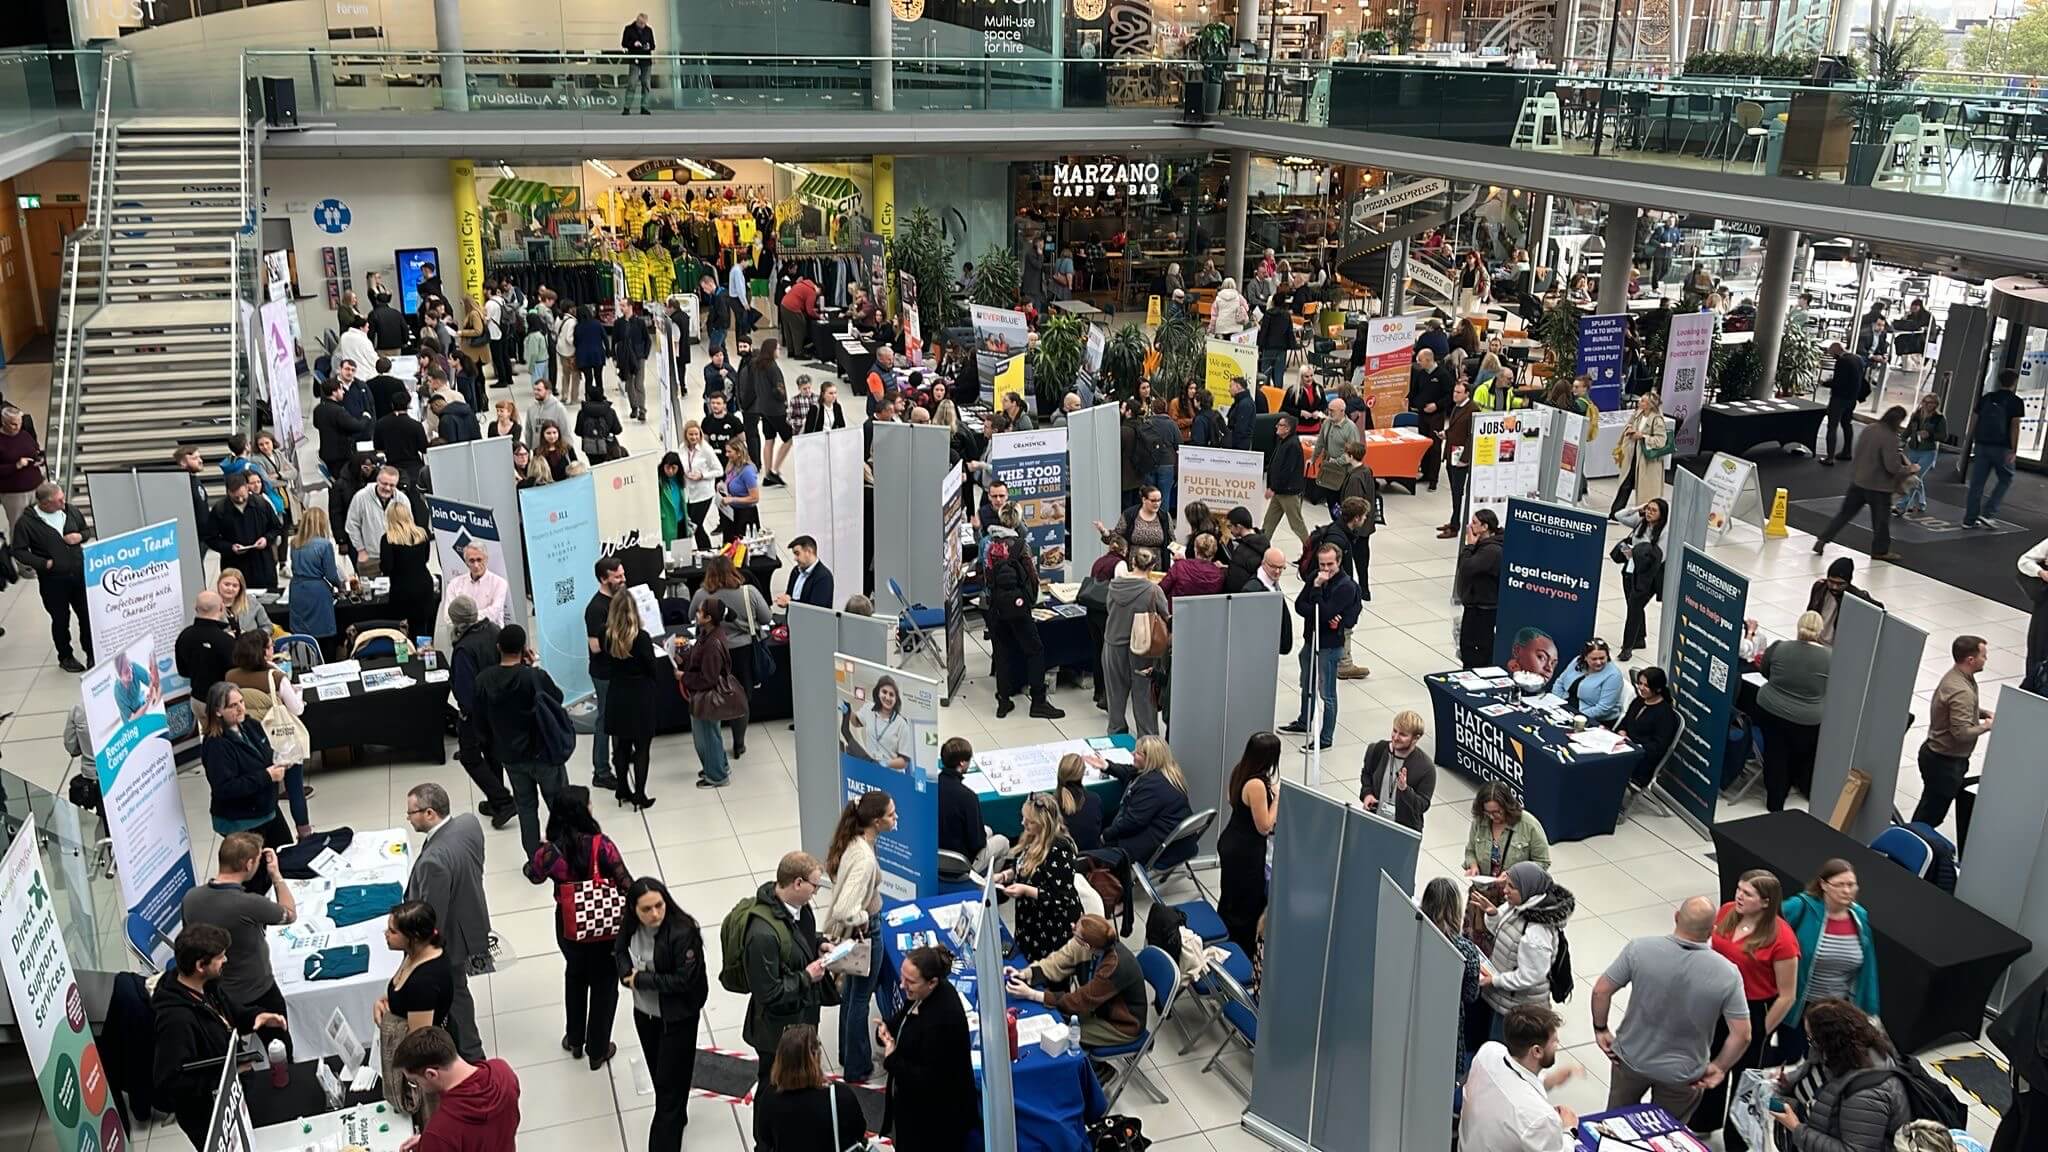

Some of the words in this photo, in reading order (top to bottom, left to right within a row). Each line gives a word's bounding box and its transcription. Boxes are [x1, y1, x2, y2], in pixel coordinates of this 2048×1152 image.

[984, 15, 1036, 28] Multi-use
[984, 29, 1021, 41] space
[984, 41, 1001, 53] for
[1003, 41, 1024, 53] hire
[1054, 163, 1159, 184] MARZANO
[1053, 185, 1095, 197] CAFE
[1107, 184, 1116, 196] &
[1128, 184, 1159, 195] BAR
[838, 194, 862, 214] CITY
[882, 203, 893, 226] City
[461, 210, 475, 236] City
[463, 240, 476, 266] Stall
[467, 269, 478, 290] The
[1480, 421, 1505, 435] JOBS
[998, 468, 1024, 481] THE
[1027, 465, 1061, 478] FOOD
[1039, 476, 1061, 485] FROM
[1184, 475, 1221, 487] FULFIL
[1225, 479, 1256, 490] YOUR
[1024, 486, 1036, 495] TO
[1188, 486, 1250, 500] POTENTIAL
[431, 506, 448, 519] Join
[449, 510, 466, 523] Our
[467, 511, 493, 529] Team!
[1514, 508, 1546, 524] HATCH
[1547, 516, 1593, 533] BRENNER
[1531, 524, 1575, 539] SOLICITORS
[89, 554, 115, 572] Join
[117, 546, 141, 560] Our
[142, 529, 175, 552] Team!
[110, 560, 169, 592] Kinnerton
[1509, 562, 1539, 577] Legal
[1540, 571, 1578, 588] clarity
[1579, 578, 1590, 589] is
[1686, 561, 1708, 580] HATCH
[1708, 572, 1738, 597] BRENNER
[1508, 576, 1524, 589] for
[1525, 583, 1578, 601] everyone
[1720, 617, 1733, 631] you
[1455, 702, 1504, 750] HATCH
[105, 725, 139, 760] Recruiting
[1455, 723, 1524, 785] BRENNER
[107, 747, 129, 770] Carers
[847, 777, 866, 794] TAKE
[11, 903, 37, 955] Direct
[19, 910, 55, 980] Payment
[27, 939, 59, 1004] Support
[34, 961, 67, 1029] Services
